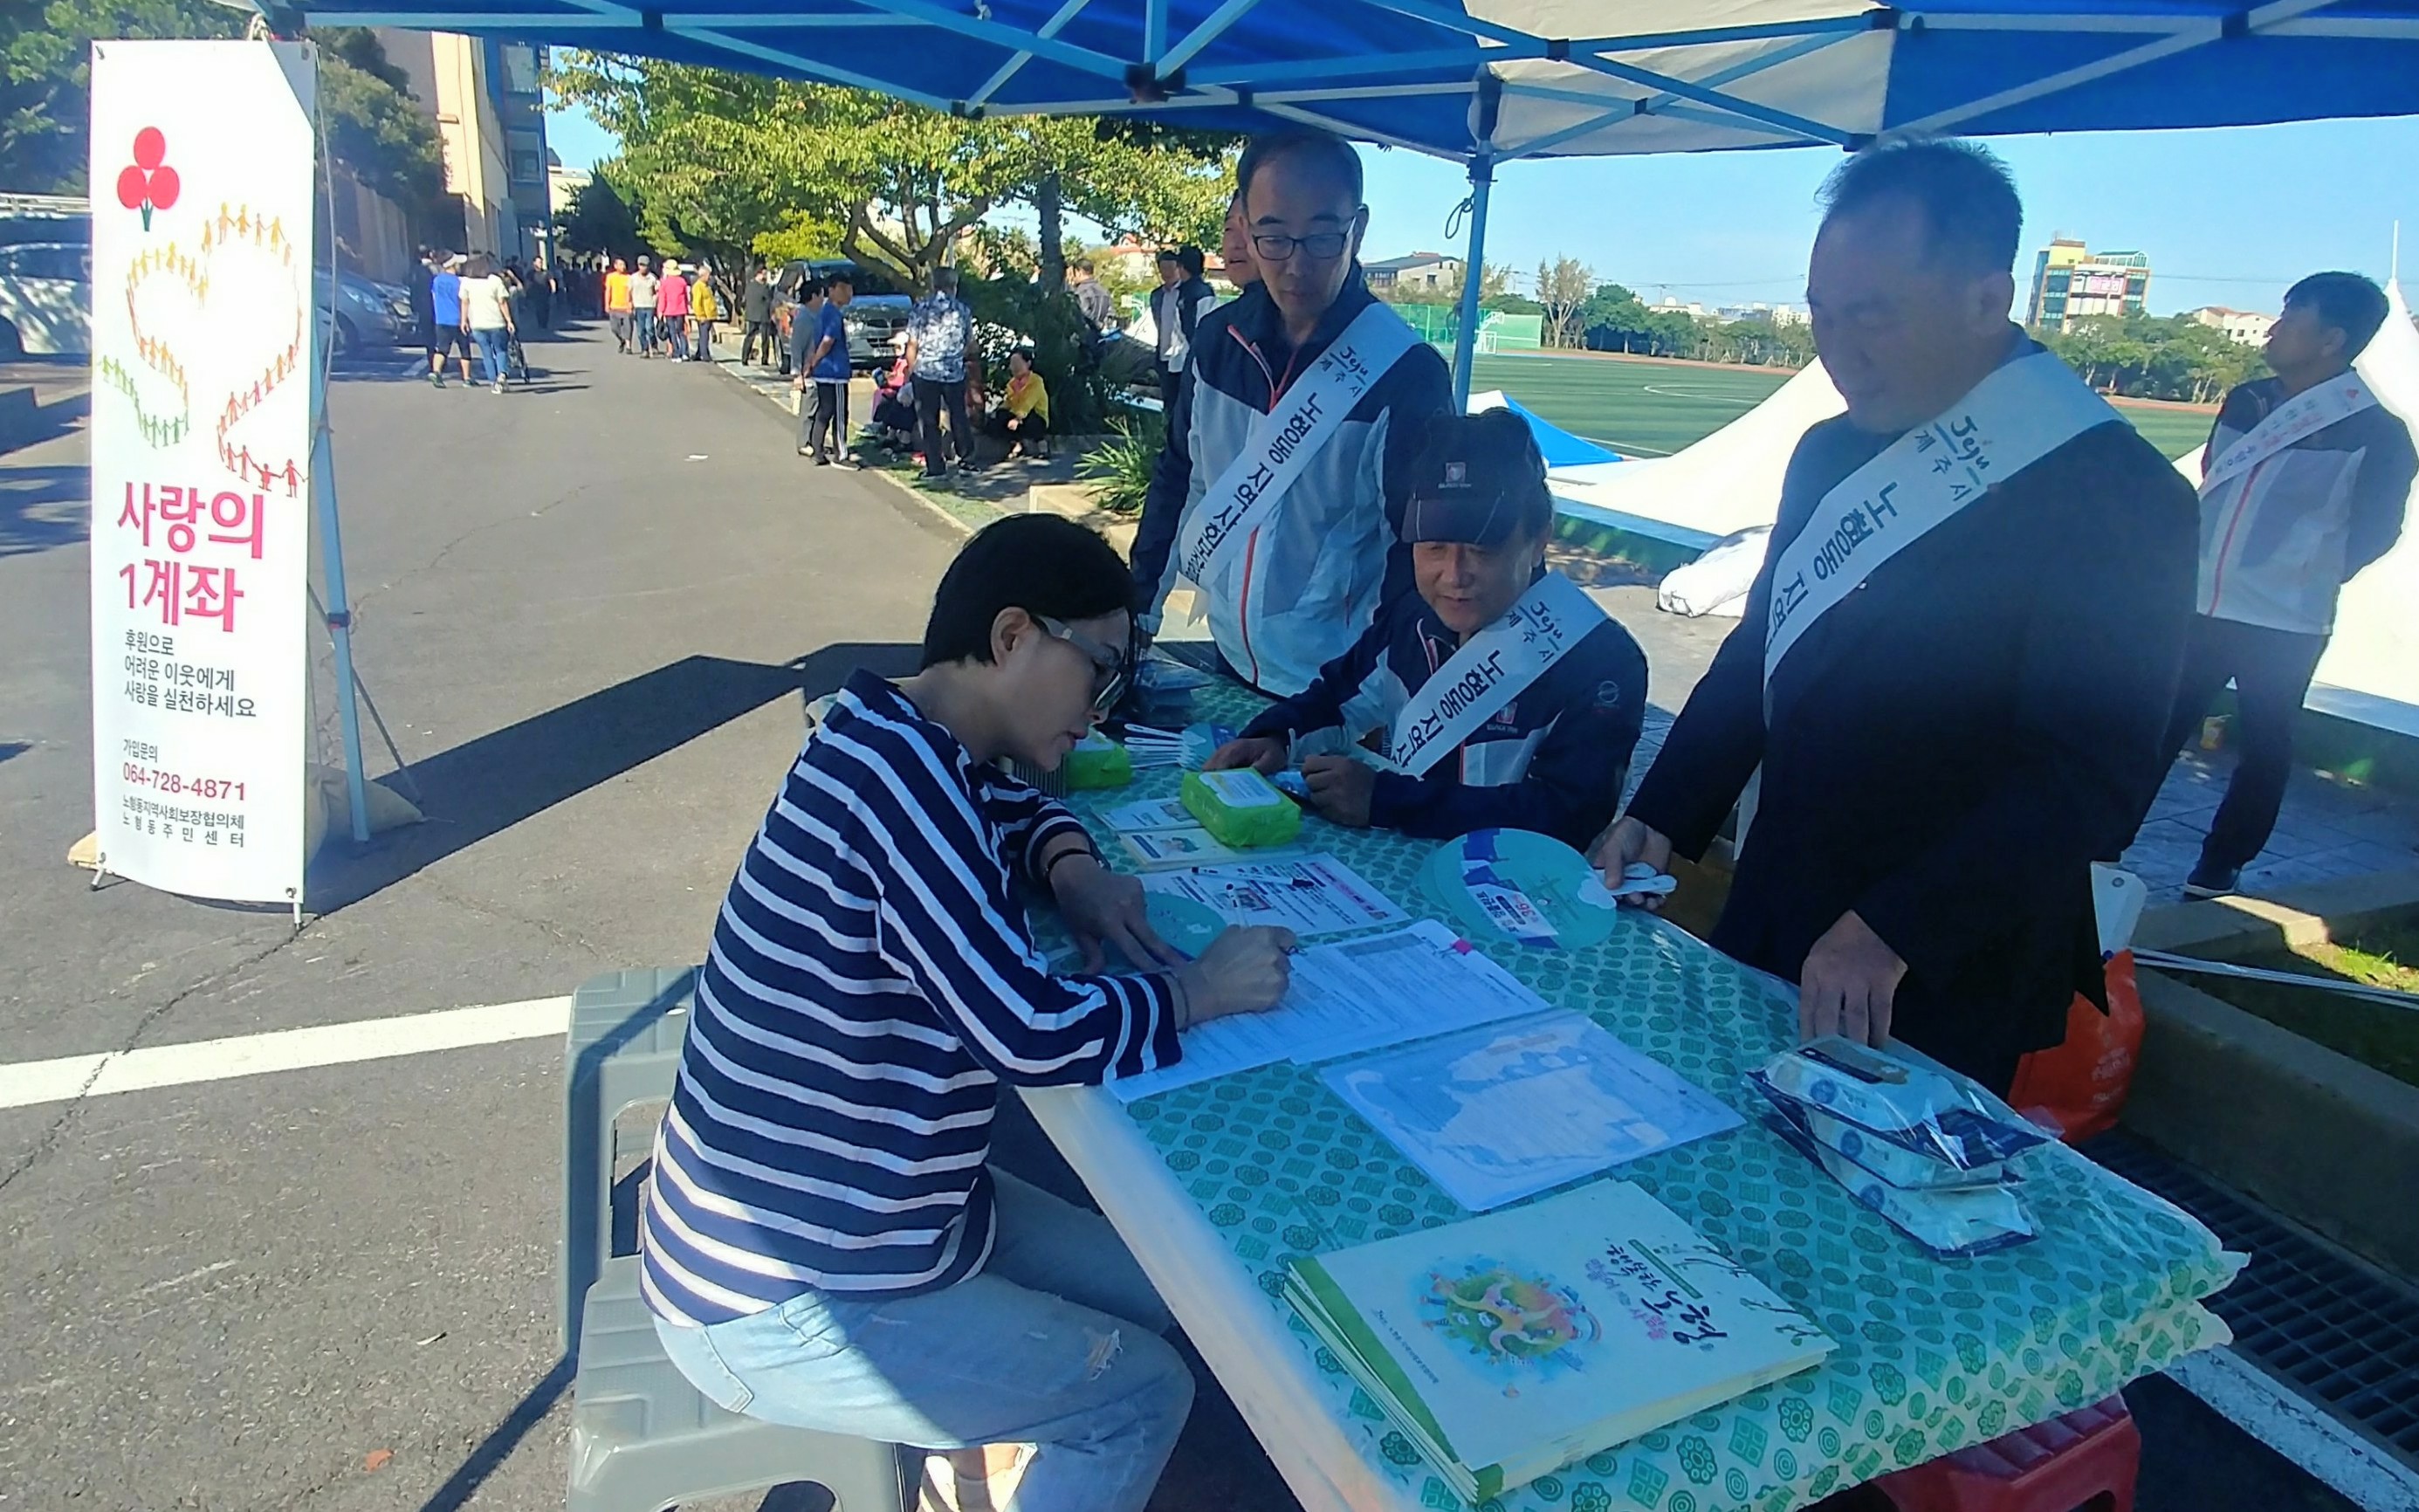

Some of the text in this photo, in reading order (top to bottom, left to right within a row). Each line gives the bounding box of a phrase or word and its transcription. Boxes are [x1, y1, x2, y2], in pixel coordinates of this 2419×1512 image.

[1339, 346, 1369, 377] Jeju
[1268, 392, 1323, 465] 노형동
[1950, 415, 1989, 471] Jeju
[117, 481, 265, 560] 사랑의
[1812, 481, 1899, 581] 노형동
[119, 558, 245, 633] 1계좌
[1529, 601, 1563, 641] Jeju
[125, 629, 175, 656] 후원으로
[124, 655, 235, 691] 어려운 이웃에게
[1440, 649, 1505, 720] 노형동
[124, 680, 258, 718] 사랑을 실천하세요
[123, 739, 159, 763] 가입문의
[122, 761, 246, 801] 064-728-4871
[122, 794, 245, 830] 노형동지역사회보장협의체
[1640, 1289, 1728, 1344] 노형
